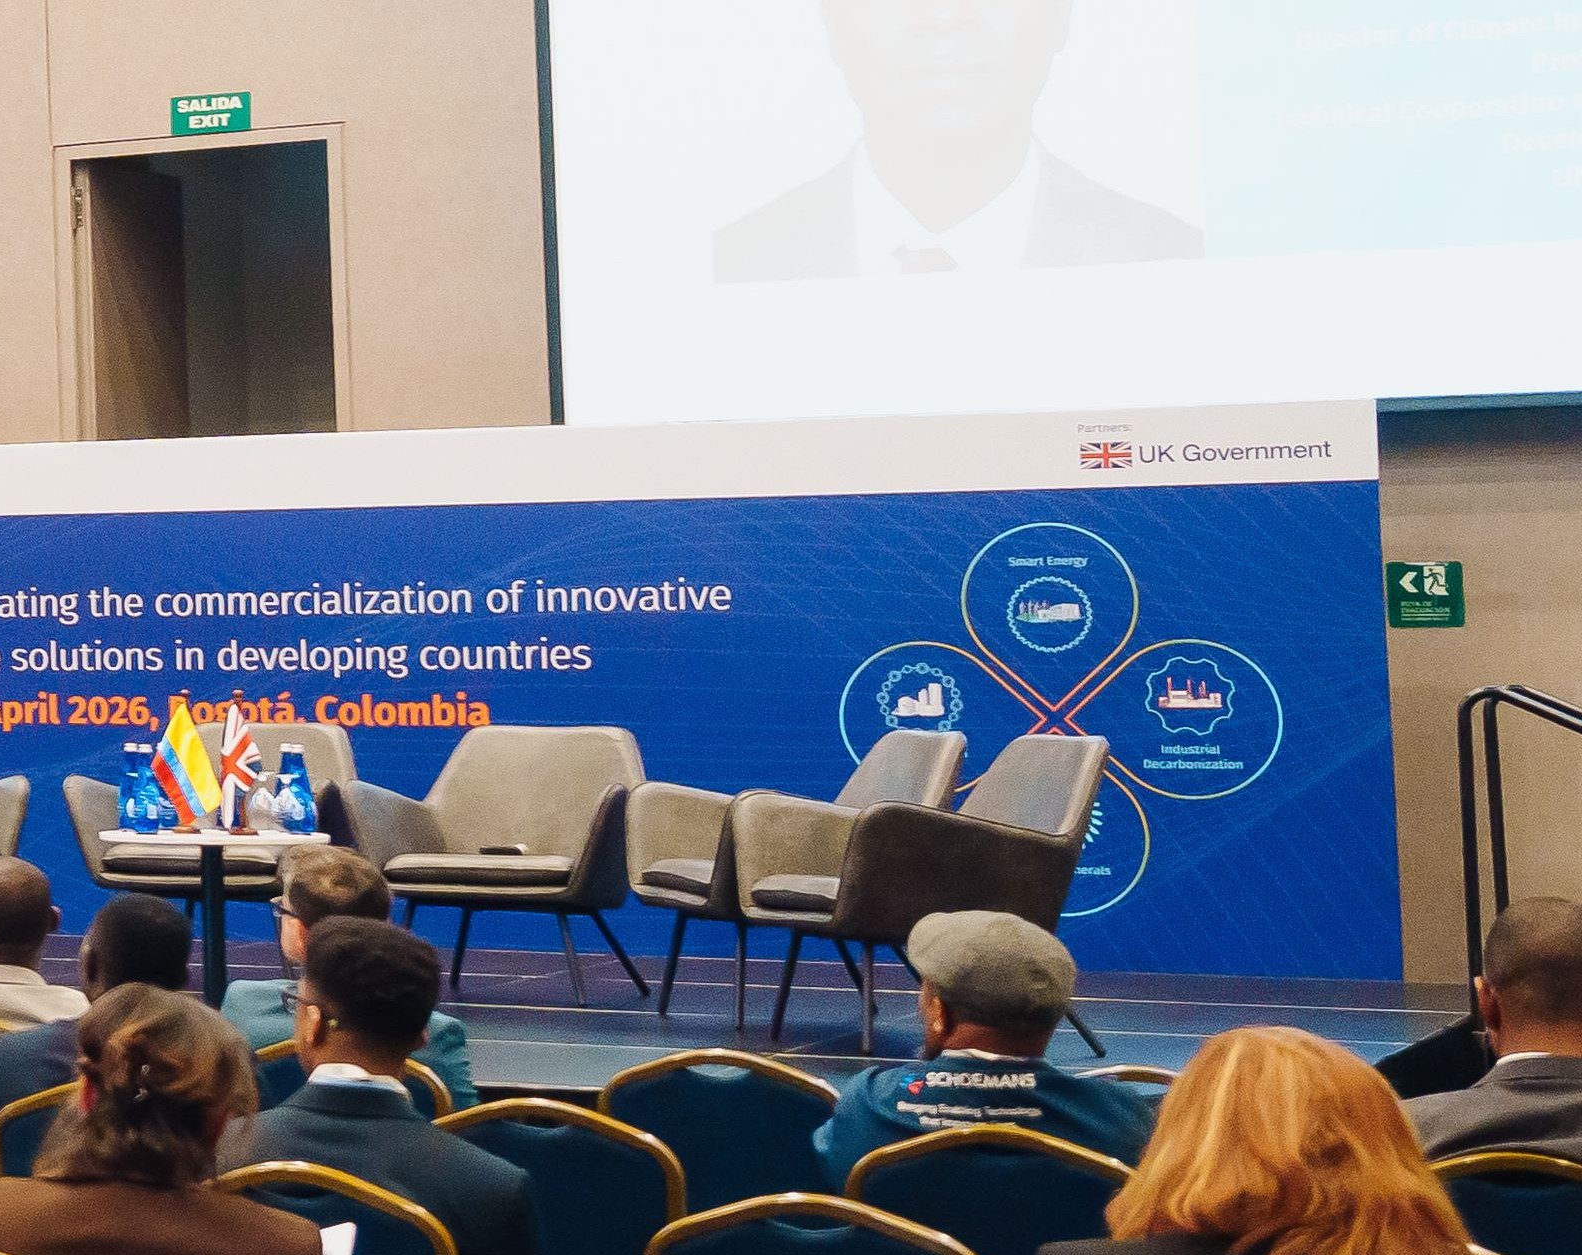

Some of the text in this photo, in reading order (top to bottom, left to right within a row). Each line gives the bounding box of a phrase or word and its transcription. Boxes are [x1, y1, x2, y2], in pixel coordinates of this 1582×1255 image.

[176, 96, 243, 113] SALIDA
[188, 113, 231, 128] EXIT
[1077, 423, 1133, 434] Partners:
[1138, 440, 1332, 463] UK Government
[1007, 556, 1089, 568] Smart Energy
[88, 586, 144, 618] the
[154, 580, 473, 618] commercialization
[485, 578, 526, 613] of
[535, 576, 732, 613] innovative
[10, 638, 164, 672] solutions
[174, 638, 205, 671] in
[216, 638, 408, 679] developing
[419, 636, 593, 671] countries
[67, 694, 159, 732] 2026,
[314, 691, 491, 727] Colombia
[1160, 744, 1221, 755] Industrial
[1143, 758, 1244, 770] Decarbonization
[1075, 865, 1112, 876] erals
[925, 1071, 1037, 1089] SCHOEMANS
